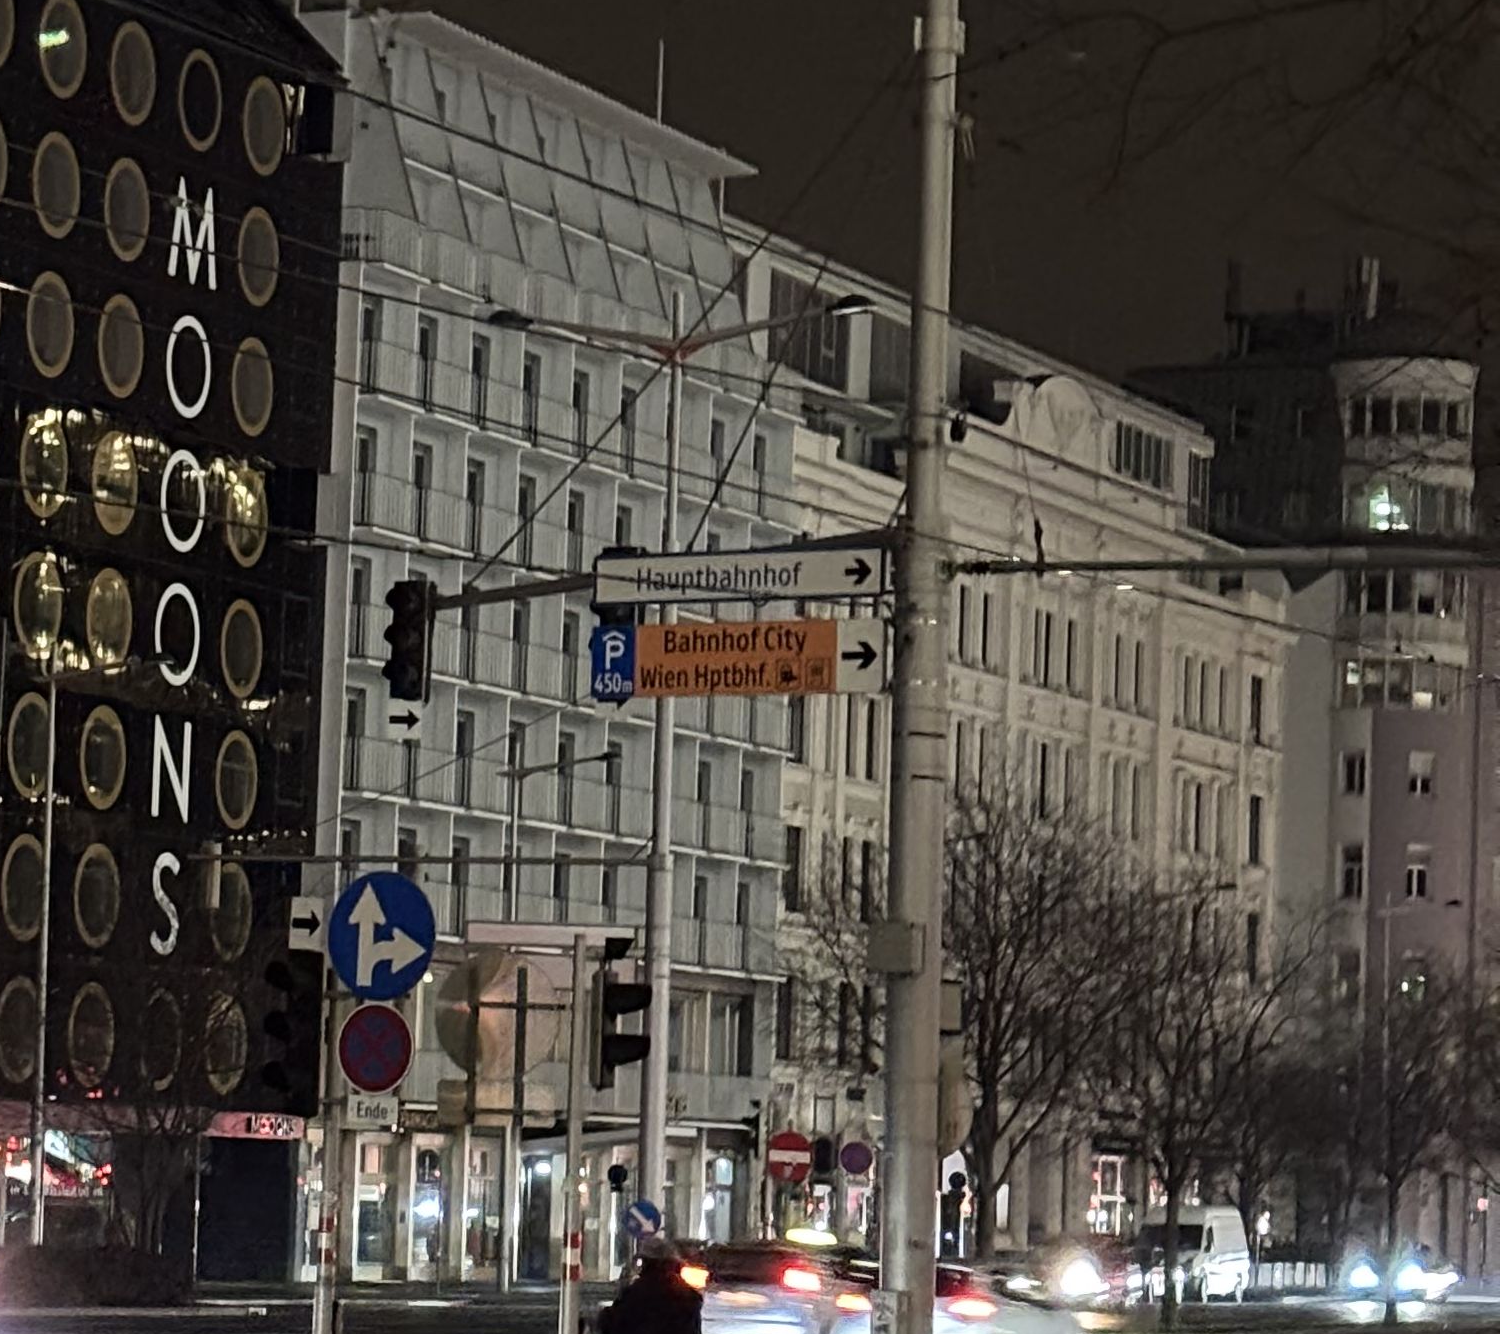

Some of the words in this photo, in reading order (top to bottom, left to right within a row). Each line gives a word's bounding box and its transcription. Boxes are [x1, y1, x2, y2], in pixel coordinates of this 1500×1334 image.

[150, 175, 217, 955] MOOONS
[636, 562, 802, 595] Hauptbahnhof
[663, 628, 758, 655] Bahnhof
[764, 626, 808, 656] City
[640, 664, 688, 689] Wien
[694, 662, 770, 692] Hptbhf.
[356, 1100, 388, 1121] Ende
